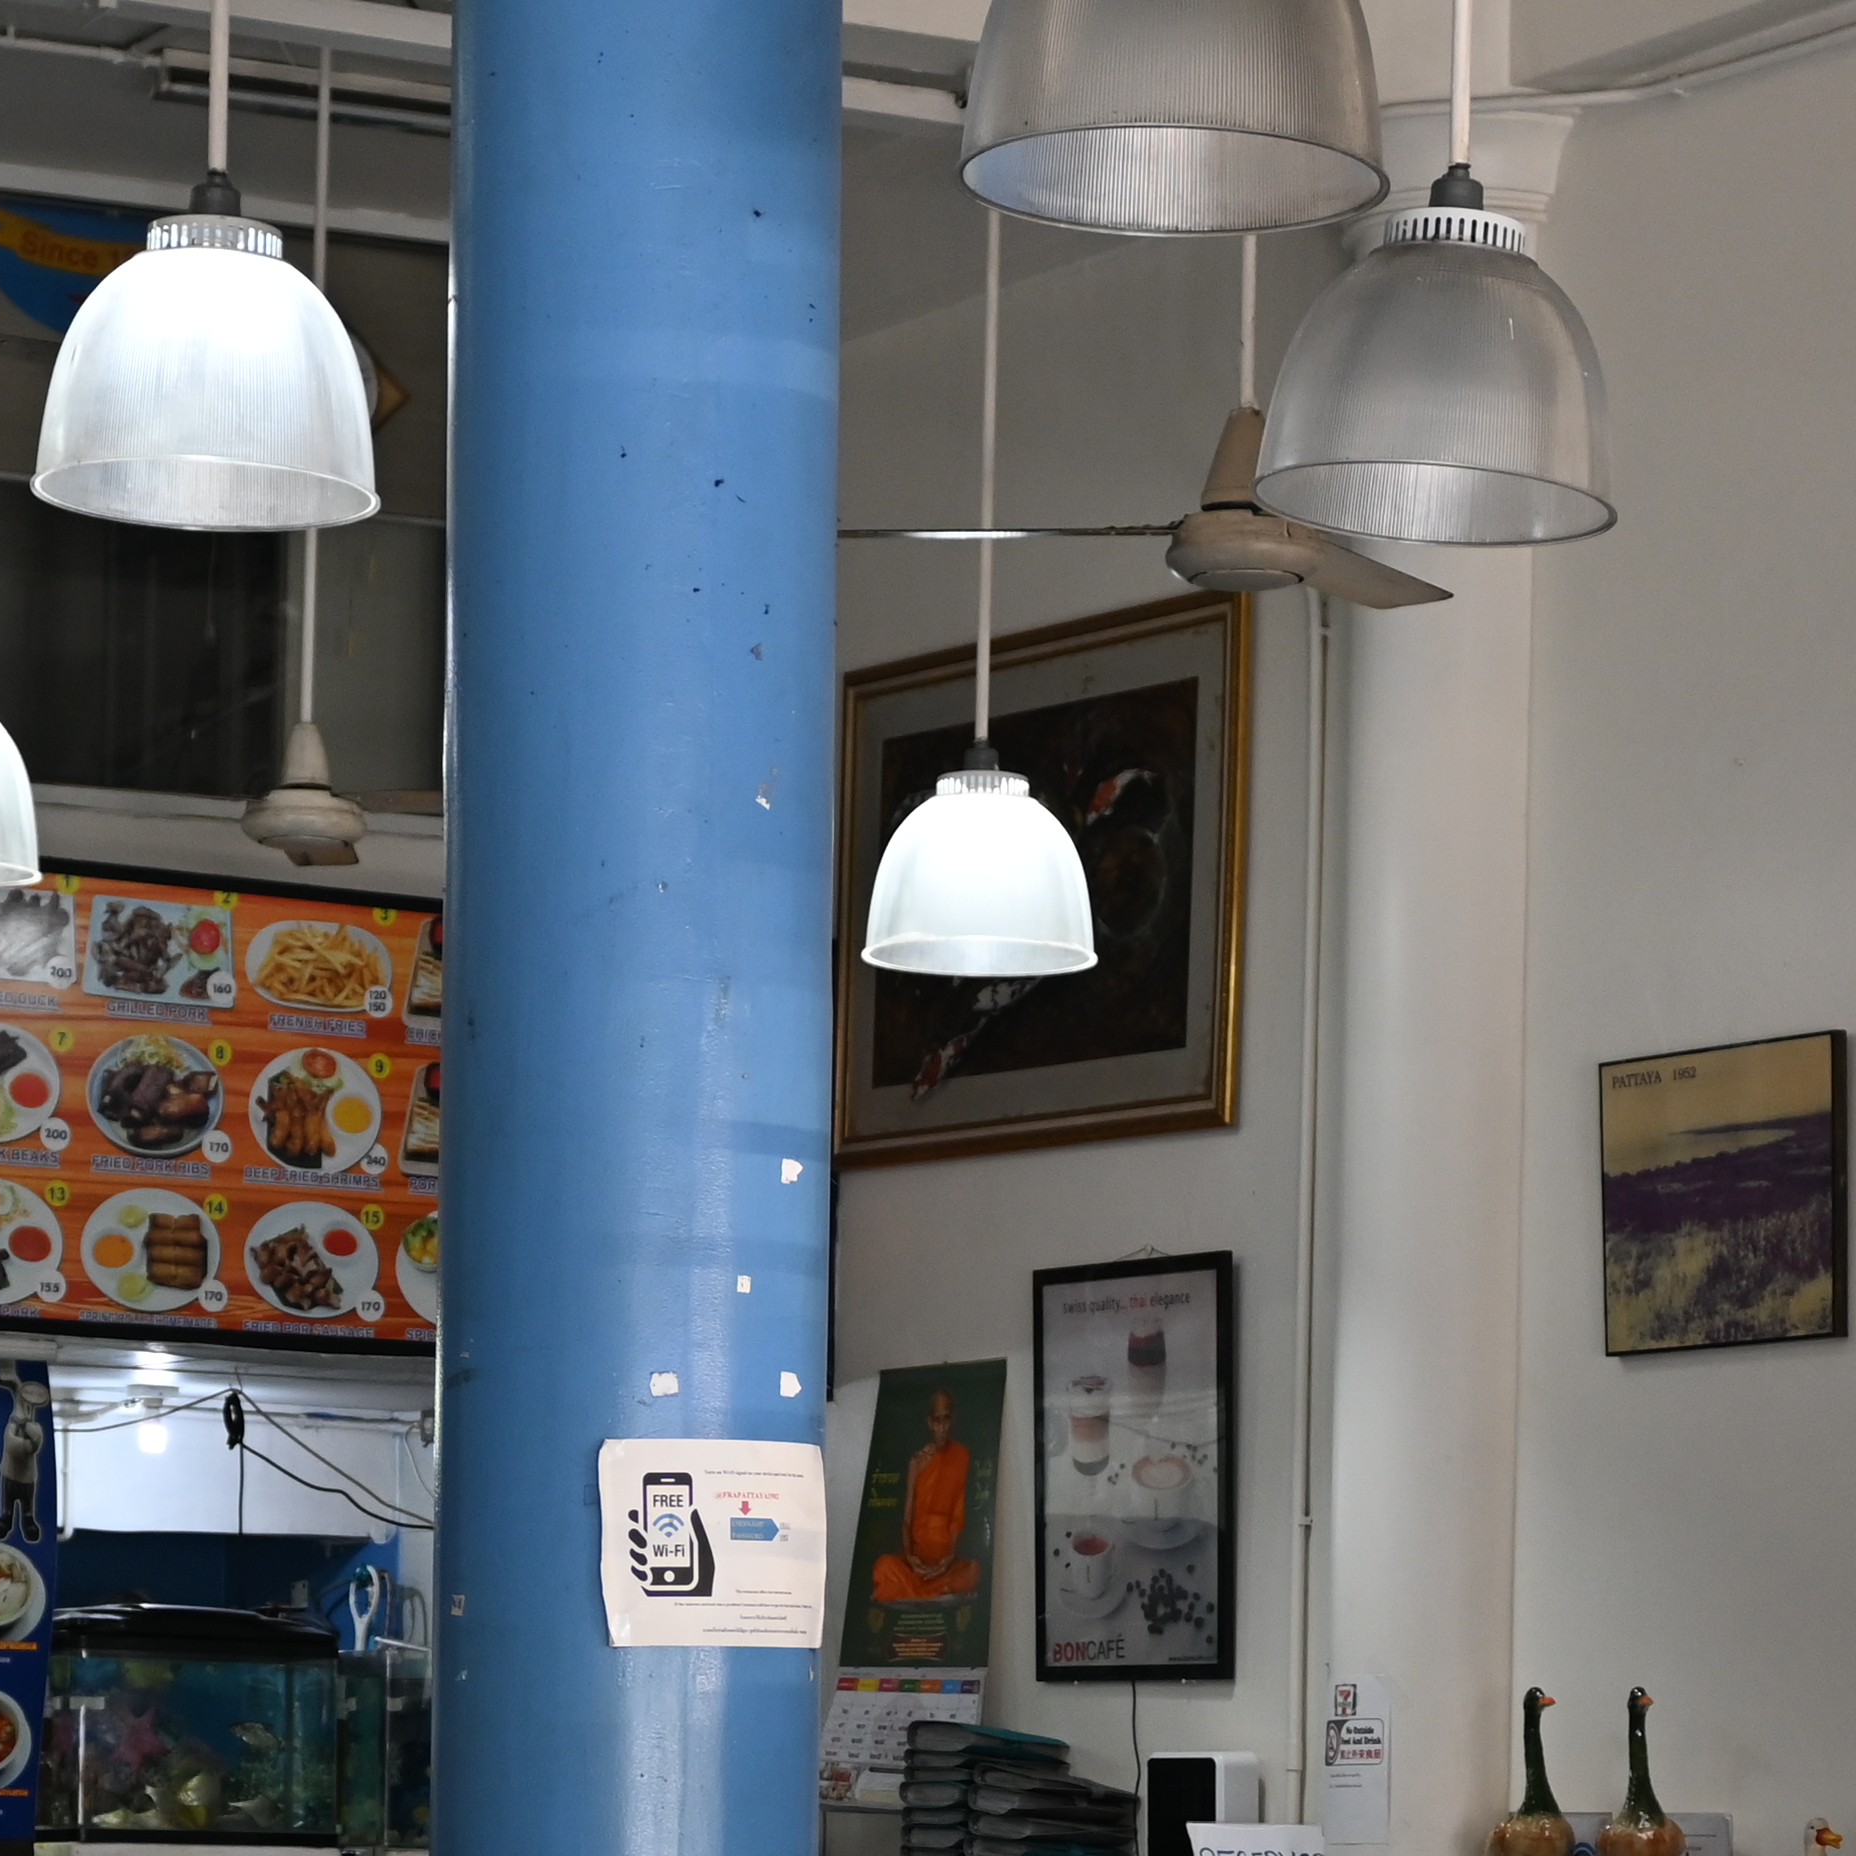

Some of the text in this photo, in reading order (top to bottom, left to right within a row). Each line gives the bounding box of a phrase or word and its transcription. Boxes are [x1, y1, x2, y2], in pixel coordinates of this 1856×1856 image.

[21, 230, 98, 268] Since
[49, 965, 73, 979] 200
[212, 983, 233, 995] 160
[368, 988, 387, 1000] 120
[14, 992, 58, 1008] DUCK
[368, 1000, 387, 1013] 150
[106, 1000, 210, 1021] GRILLED PORK
[269, 1013, 366, 1033] FRENCH FRIES
[57, 1031, 67, 1046] 7
[215, 1045, 225, 1060] 8
[375, 1058, 385, 1073] 9
[1611, 1065, 1697, 1089] PATTAYA 1952
[44, 1128, 68, 1142] 200
[208, 1141, 229, 1153] 170
[11, 1148, 59, 1164] BEAKS
[365, 1154, 386, 1167] 240
[92, 1154, 210, 1176] FRIED PORK RIBS
[244, 1166, 380, 1187] DEEP FRIED SHRIMPS
[48, 1187, 65, 1202] 13
[206, 1200, 225, 1215] 14
[362, 1210, 381, 1225] 15
[40, 1282, 60, 1293] 155
[203, 1290, 223, 1302] 170
[1063, 1299, 1087, 1315] swiss
[1150, 1292, 1191, 1311] elegance
[1, 1305, 41, 1319] PORK
[360, 1300, 381, 1312] 170
[243, 1320, 375, 1340] FRIED POR SAUSAGE
[652, 1494, 685, 1508] FREE
[652, 1543, 686, 1558] Wi-Fi
[1052, 1633, 1126, 1663] BONCAFÉ
[1345, 1726, 1375, 1735] No Outside
[1352, 1736, 1364, 1745] And
[1364, 1736, 1382, 1745] Drink
